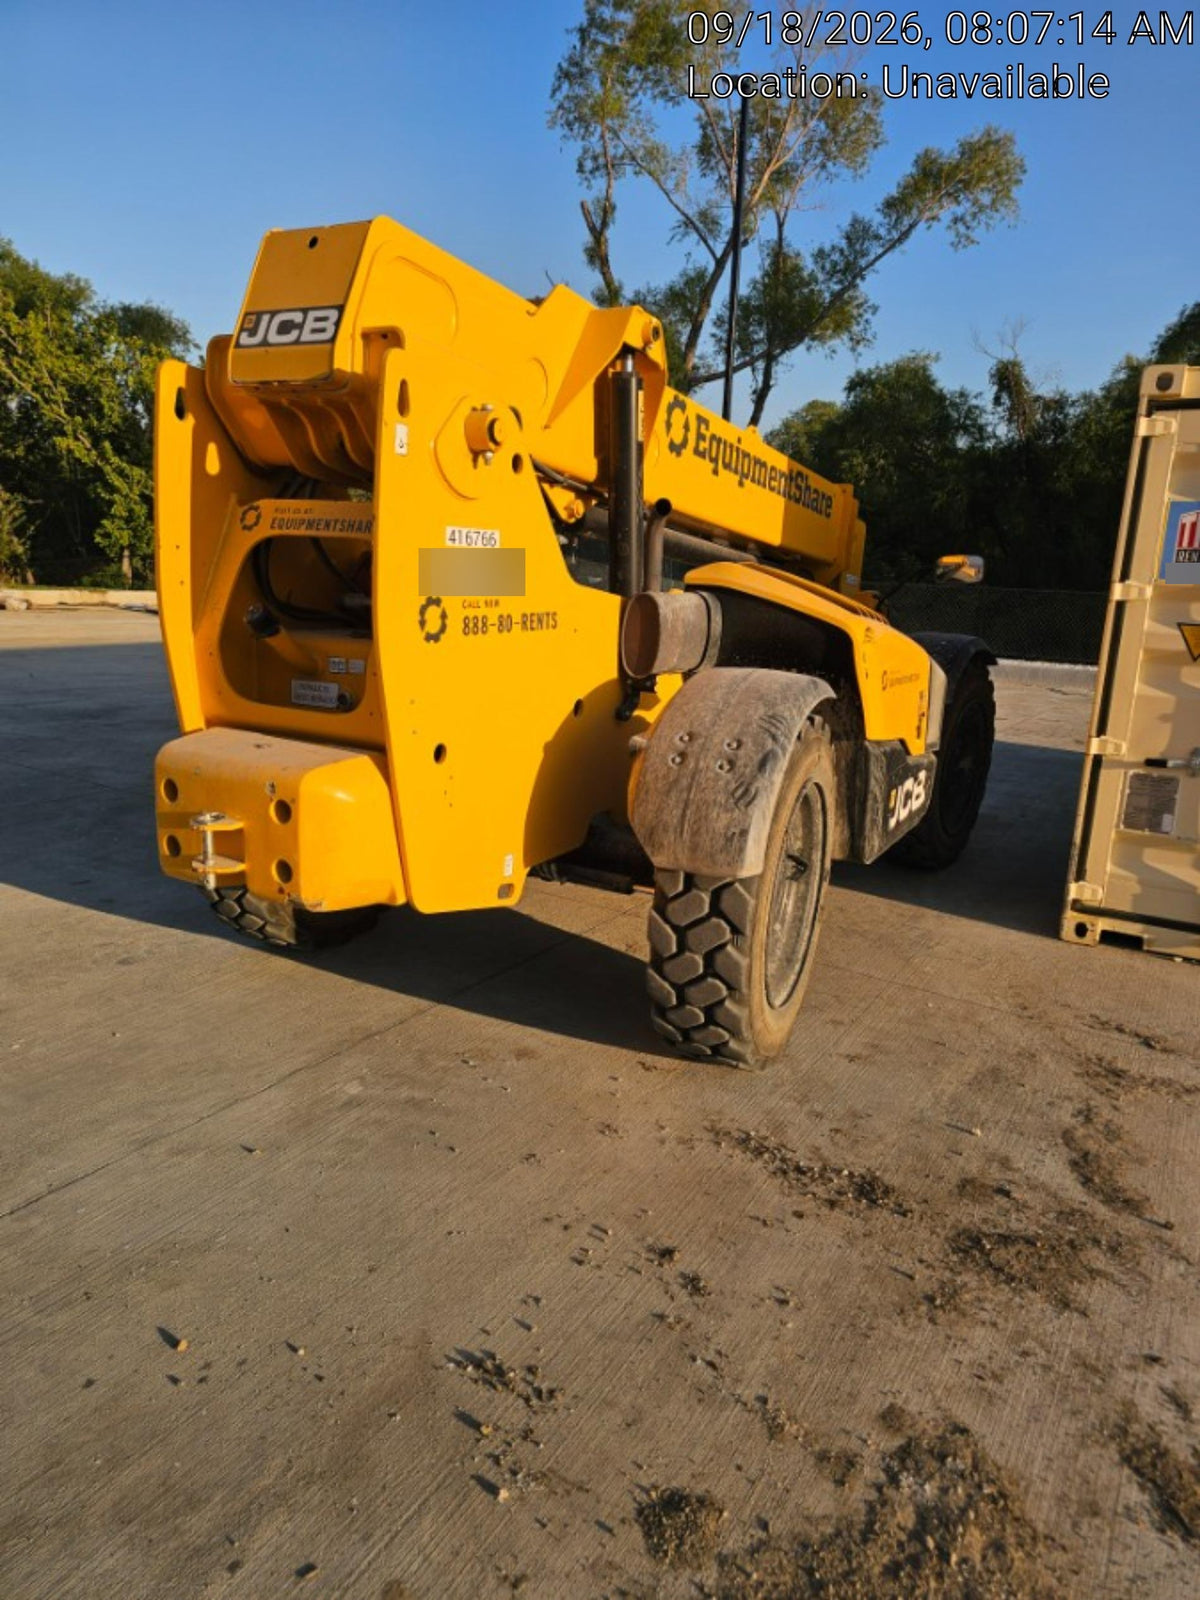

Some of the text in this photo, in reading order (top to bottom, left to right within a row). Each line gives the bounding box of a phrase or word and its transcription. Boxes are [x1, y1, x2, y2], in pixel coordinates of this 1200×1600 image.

[239, 308, 340, 346] JCB
[693, 412, 833, 519] EquipmentShare
[270, 516, 373, 534] EQUIPMENTSHAR
[448, 529, 497, 547] 416766
[1178, 550, 1200, 562] REN
[462, 611, 558, 636] 888-80-RENTS
[888, 768, 927, 832] JCB
